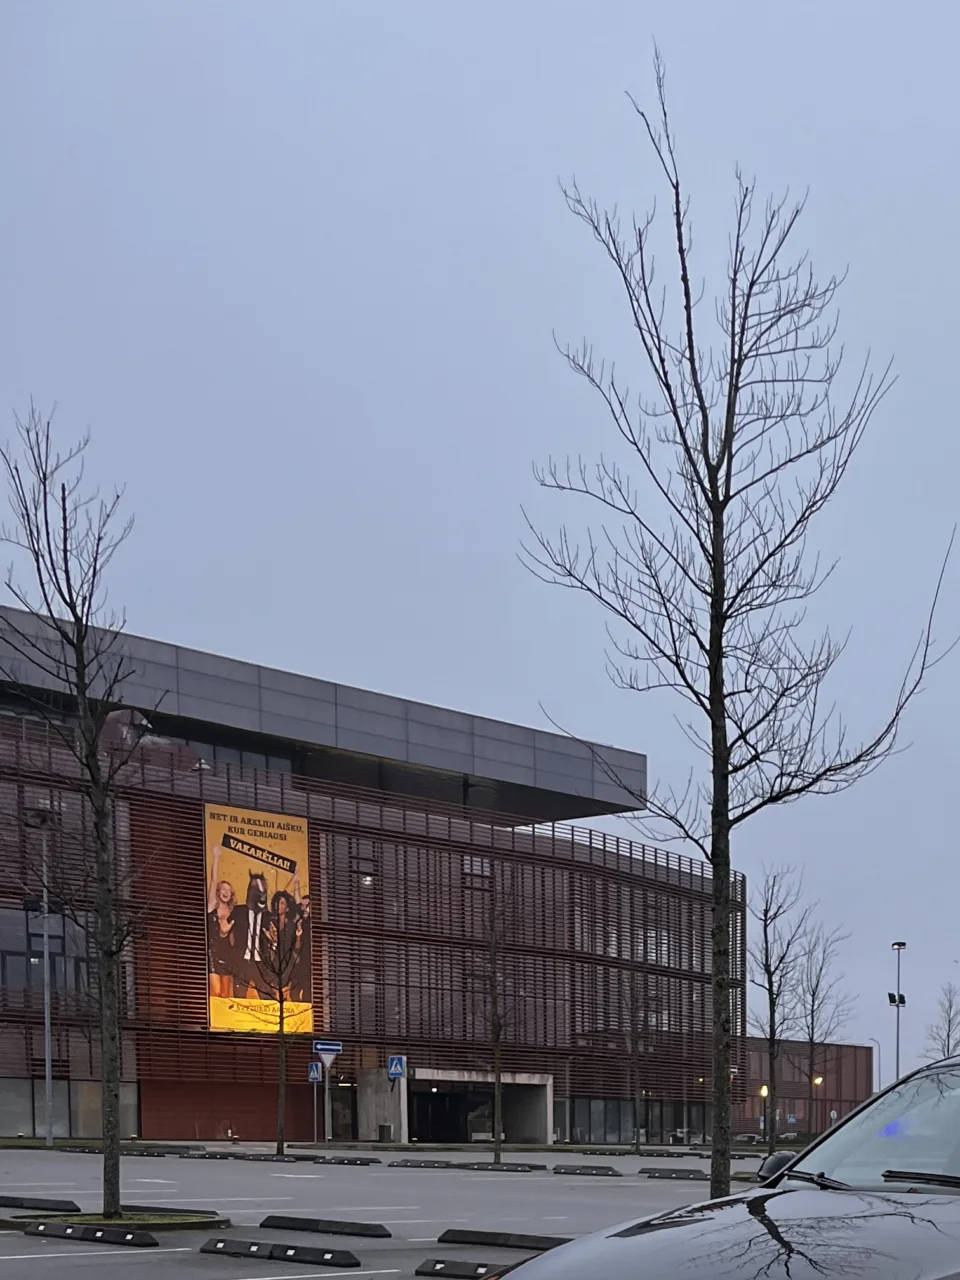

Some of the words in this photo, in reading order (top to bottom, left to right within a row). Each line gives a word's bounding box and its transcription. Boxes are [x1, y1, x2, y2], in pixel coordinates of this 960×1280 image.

[209, 812, 228, 822] NET
[229, 815, 239, 823] IR
[240, 817, 275, 829] ARKLIUI
[227, 826, 245, 836] KUR
[247, 829, 287, 841] GERIAUSI
